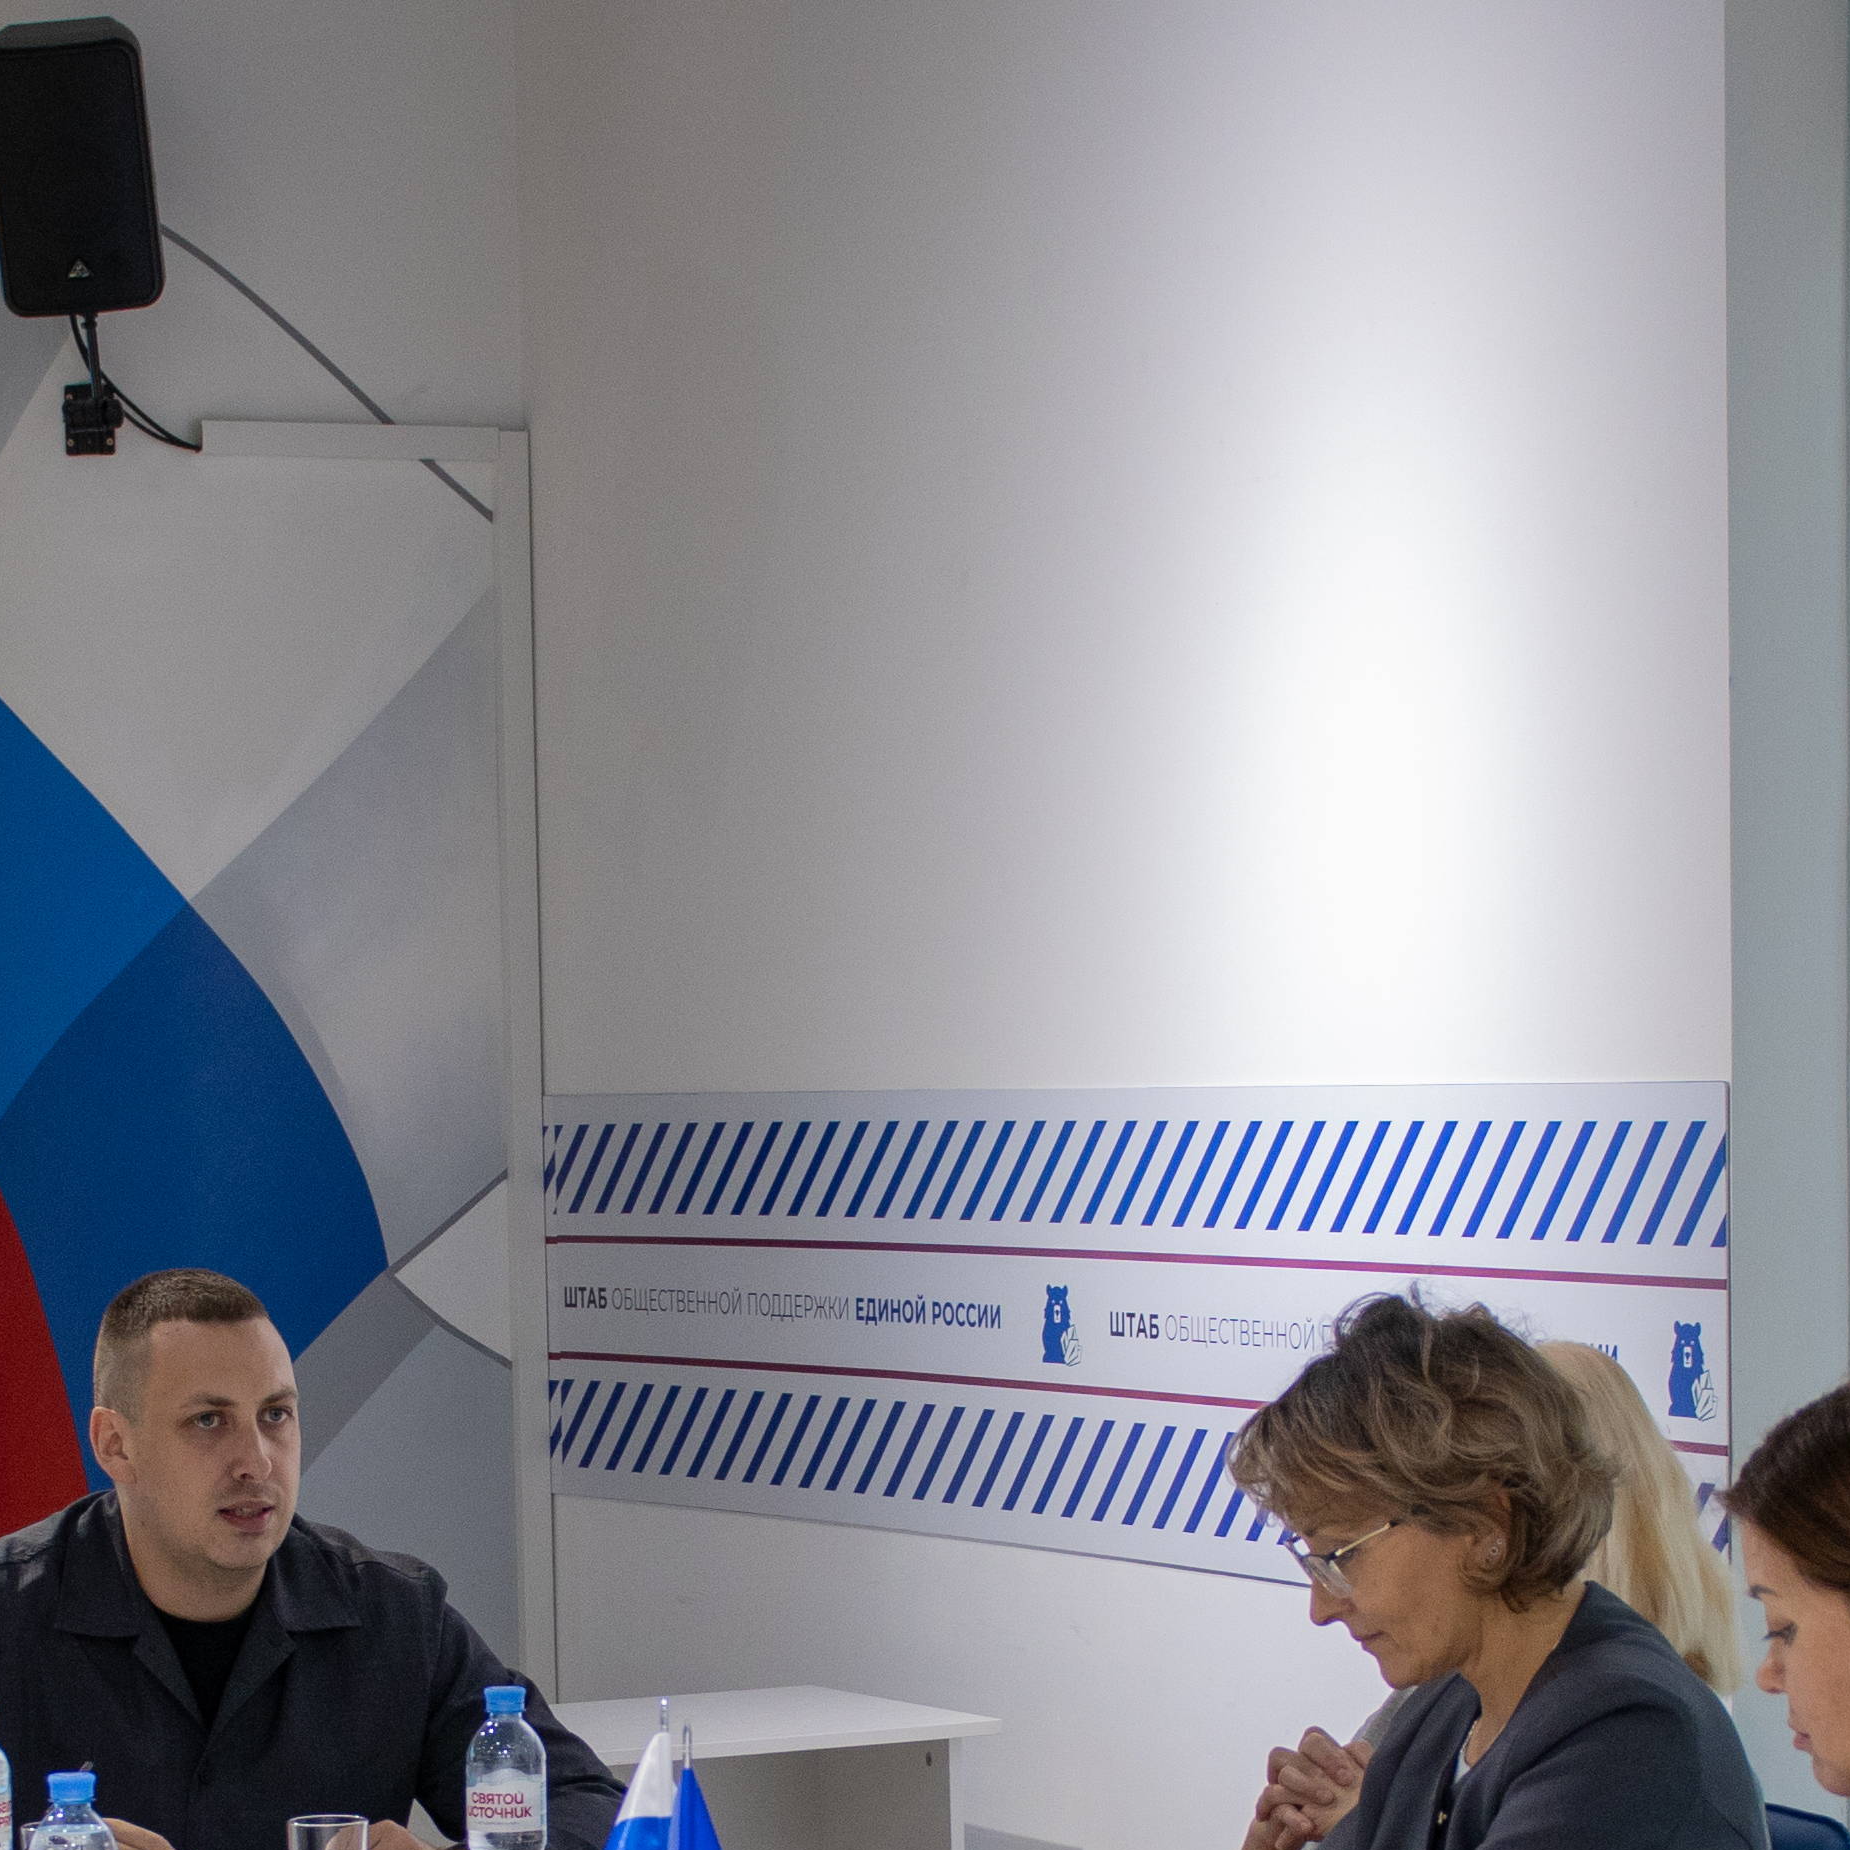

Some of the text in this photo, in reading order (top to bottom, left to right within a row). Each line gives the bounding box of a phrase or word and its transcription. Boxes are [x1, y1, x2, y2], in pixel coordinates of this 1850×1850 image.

[563, 1286, 1002, 1330] ШТАБ ОБЩЕСТВЕННОЙ ПОДДЕРЖКИ ЕДИНОЙ РОССИИ
[1109, 1310, 1160, 1340] ШТАБ
[1164, 1311, 1316, 1352] ОБЩЕСТВЕННОЙ
